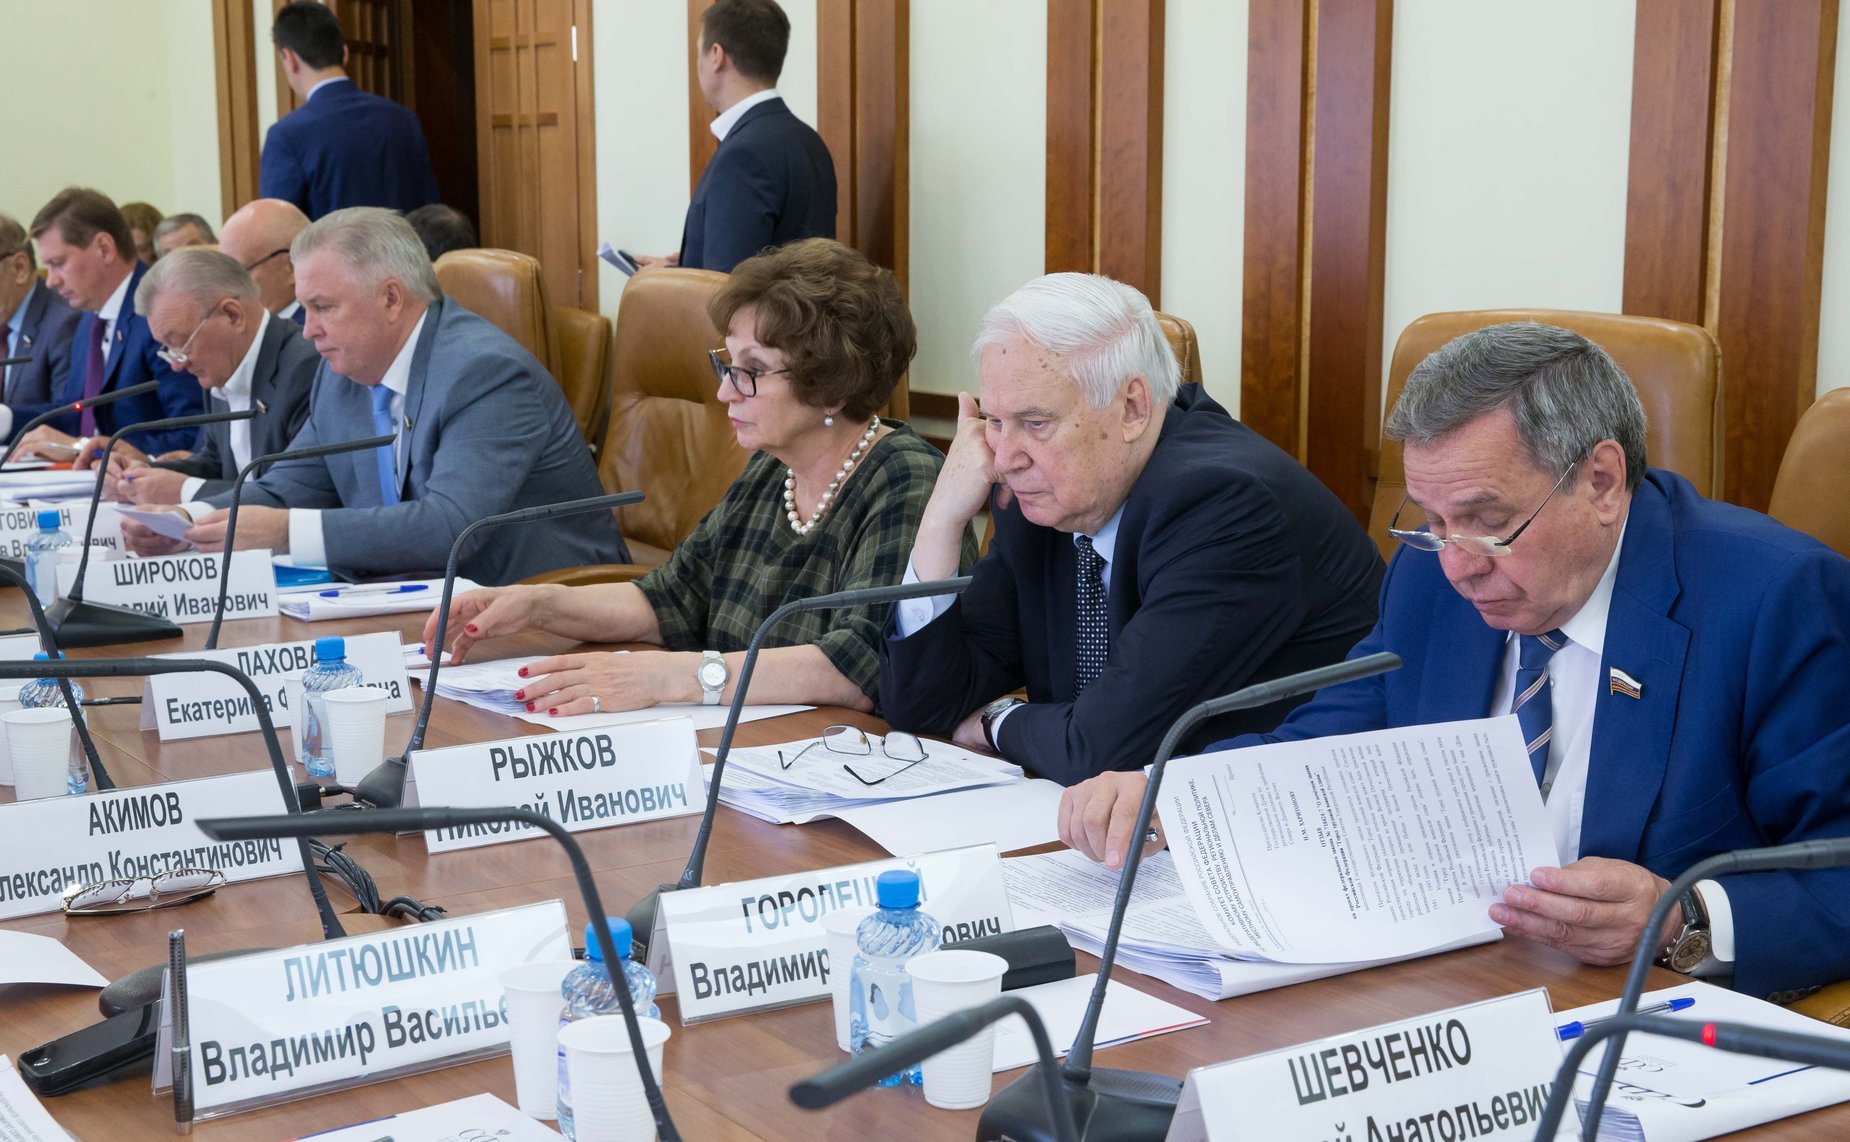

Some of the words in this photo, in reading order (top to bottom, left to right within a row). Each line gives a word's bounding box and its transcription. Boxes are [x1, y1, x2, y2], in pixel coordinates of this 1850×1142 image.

[0, 508, 72, 531] ГОВИН
[113, 558, 217, 586] ШИРОКОВ
[174, 592, 269, 616] Иванович
[489, 734, 616, 781] РЫЖКОВ
[89, 791, 183, 836] АКИМОВ
[557, 782, 688, 824] Иванович
[1201, 795, 1213, 819] СЕВЕРА
[1191, 820, 1210, 866] ФЕДЕРАЦИИ
[1208, 819, 1221, 842] ДЕЛАМ
[108, 838, 283, 887] Константинович
[1205, 866, 1221, 894] СОВЕТА
[1217, 895, 1235, 926] КОМИТЕТ
[284, 926, 479, 1002] ЛИТЮШКИН
[690, 948, 831, 1000] Владимир
[201, 1021, 375, 1086] Владимир
[1288, 1018, 1472, 1106] ШЕВЧЕНКО
